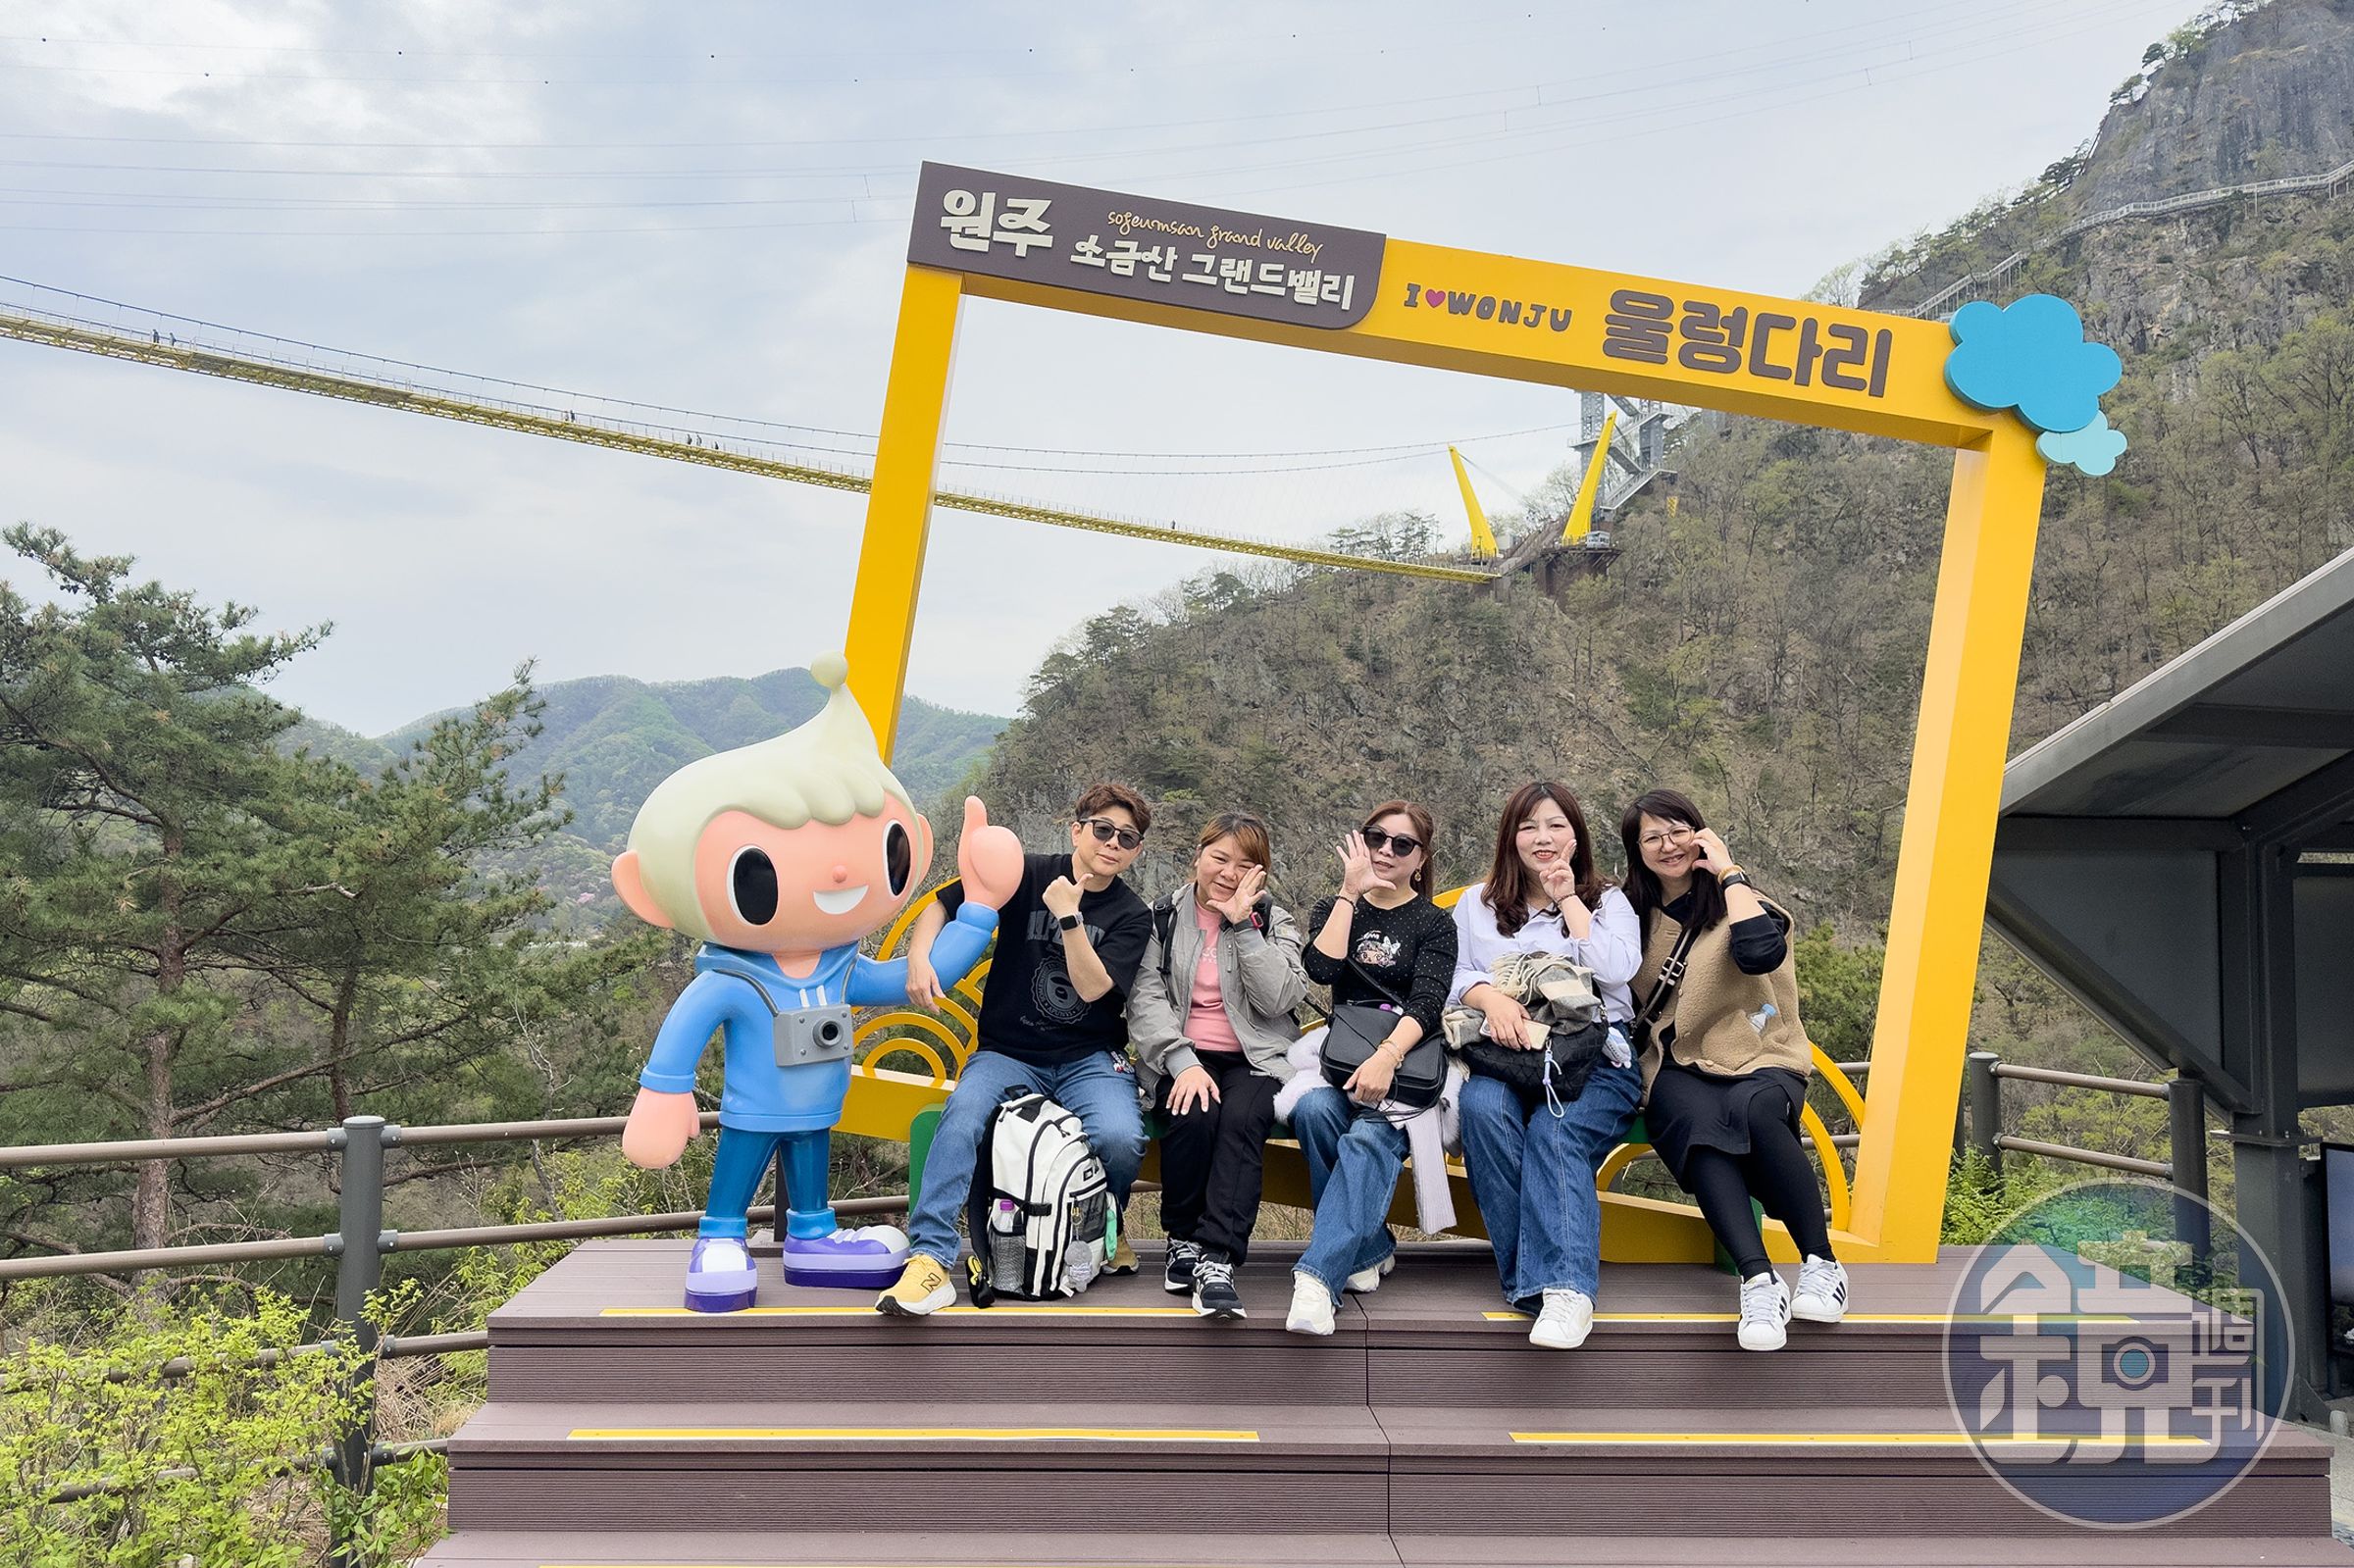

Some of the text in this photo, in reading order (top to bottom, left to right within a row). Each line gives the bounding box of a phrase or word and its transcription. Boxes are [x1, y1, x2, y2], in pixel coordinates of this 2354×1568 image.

[940, 188, 1053, 258] 원주
[1107, 211, 1323, 264] sogeumsan grand valley
[1070, 234, 1356, 311] 소금산 그랜드밸리
[1448, 290, 1573, 332] WONJU
[1603, 289, 1893, 399] 울렁다리
